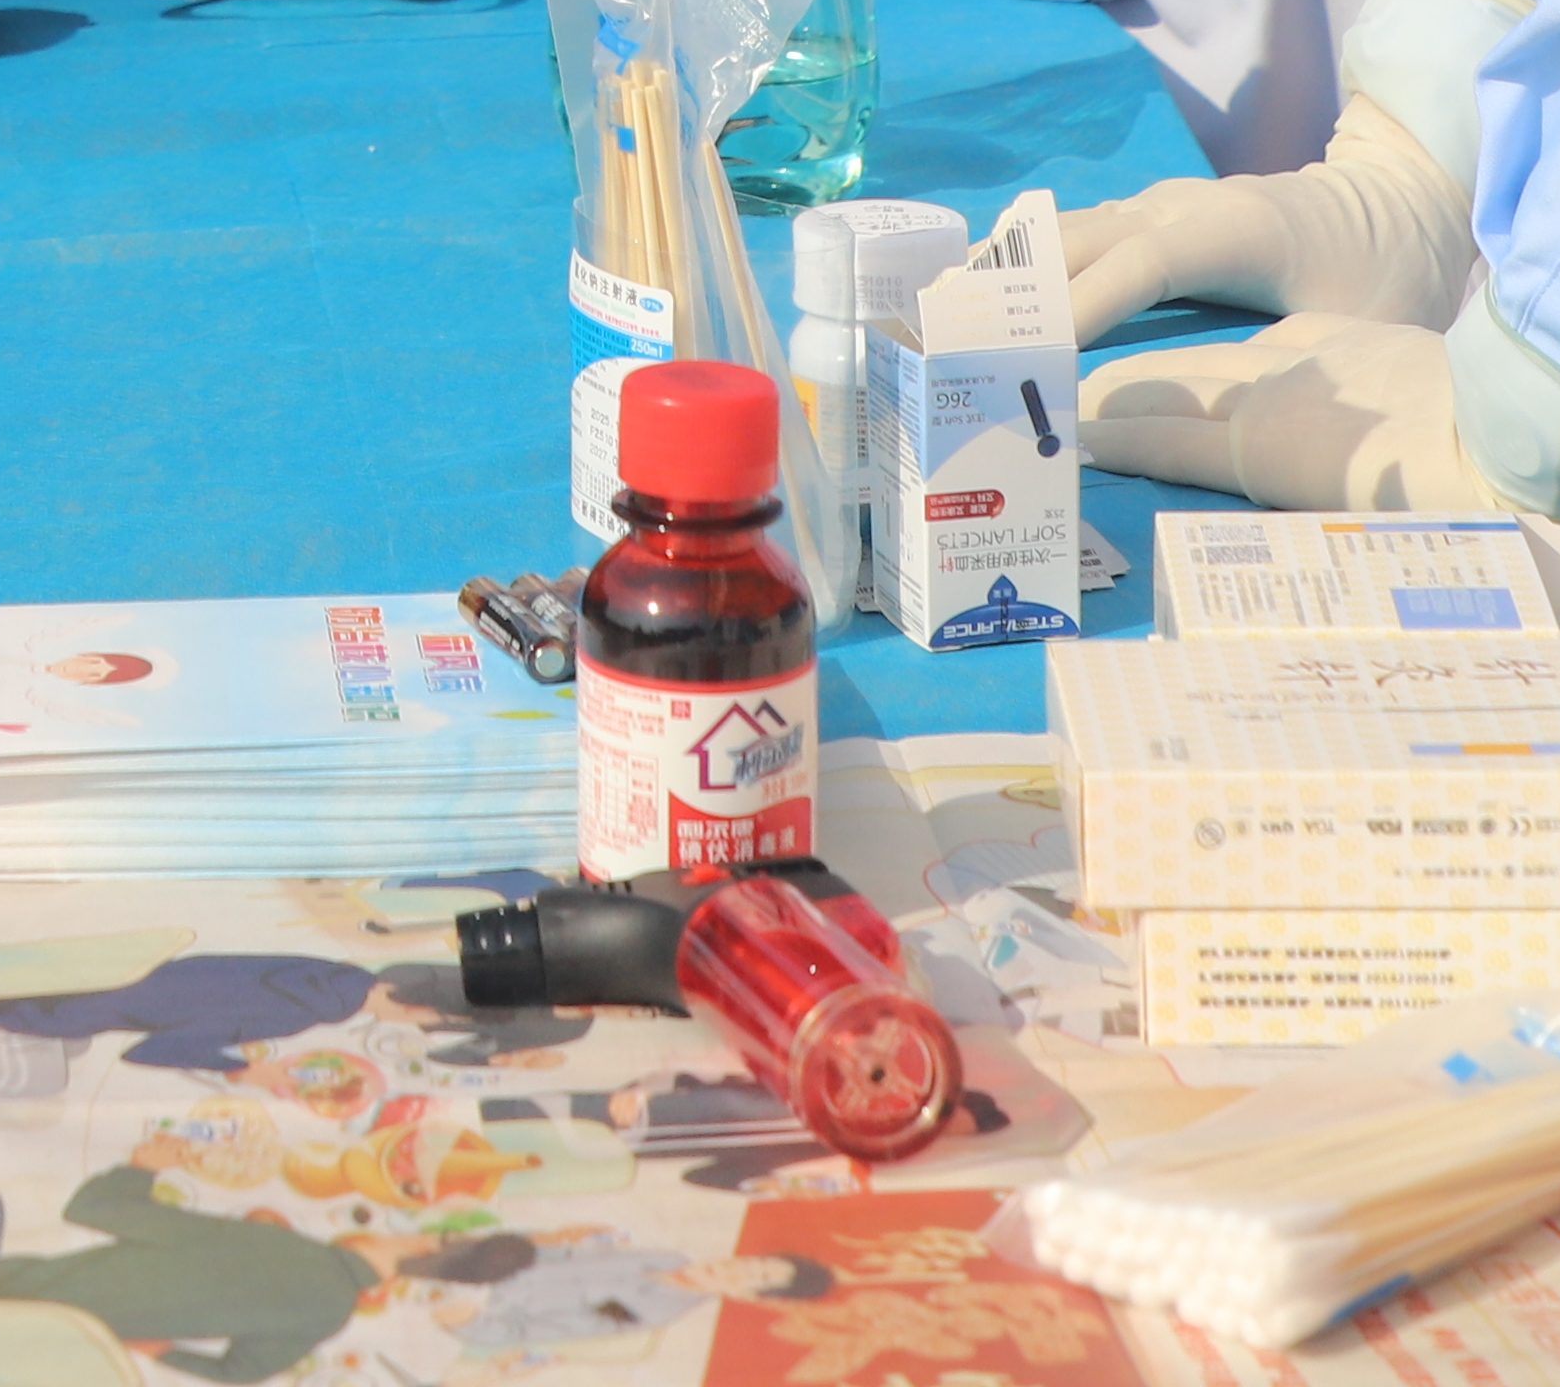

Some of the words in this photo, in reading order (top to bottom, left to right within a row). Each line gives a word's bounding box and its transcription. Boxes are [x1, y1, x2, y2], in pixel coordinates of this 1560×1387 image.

[630, 338, 663, 359] 250ml
[936, 391, 972, 409] 26G
[936, 528, 1015, 550] LANCETS
[1019, 523, 1067, 544] SOFT
[937, 546, 1068, 574] 一次性使用采血针
[1273, 658, 1558, 689] 针灸针
